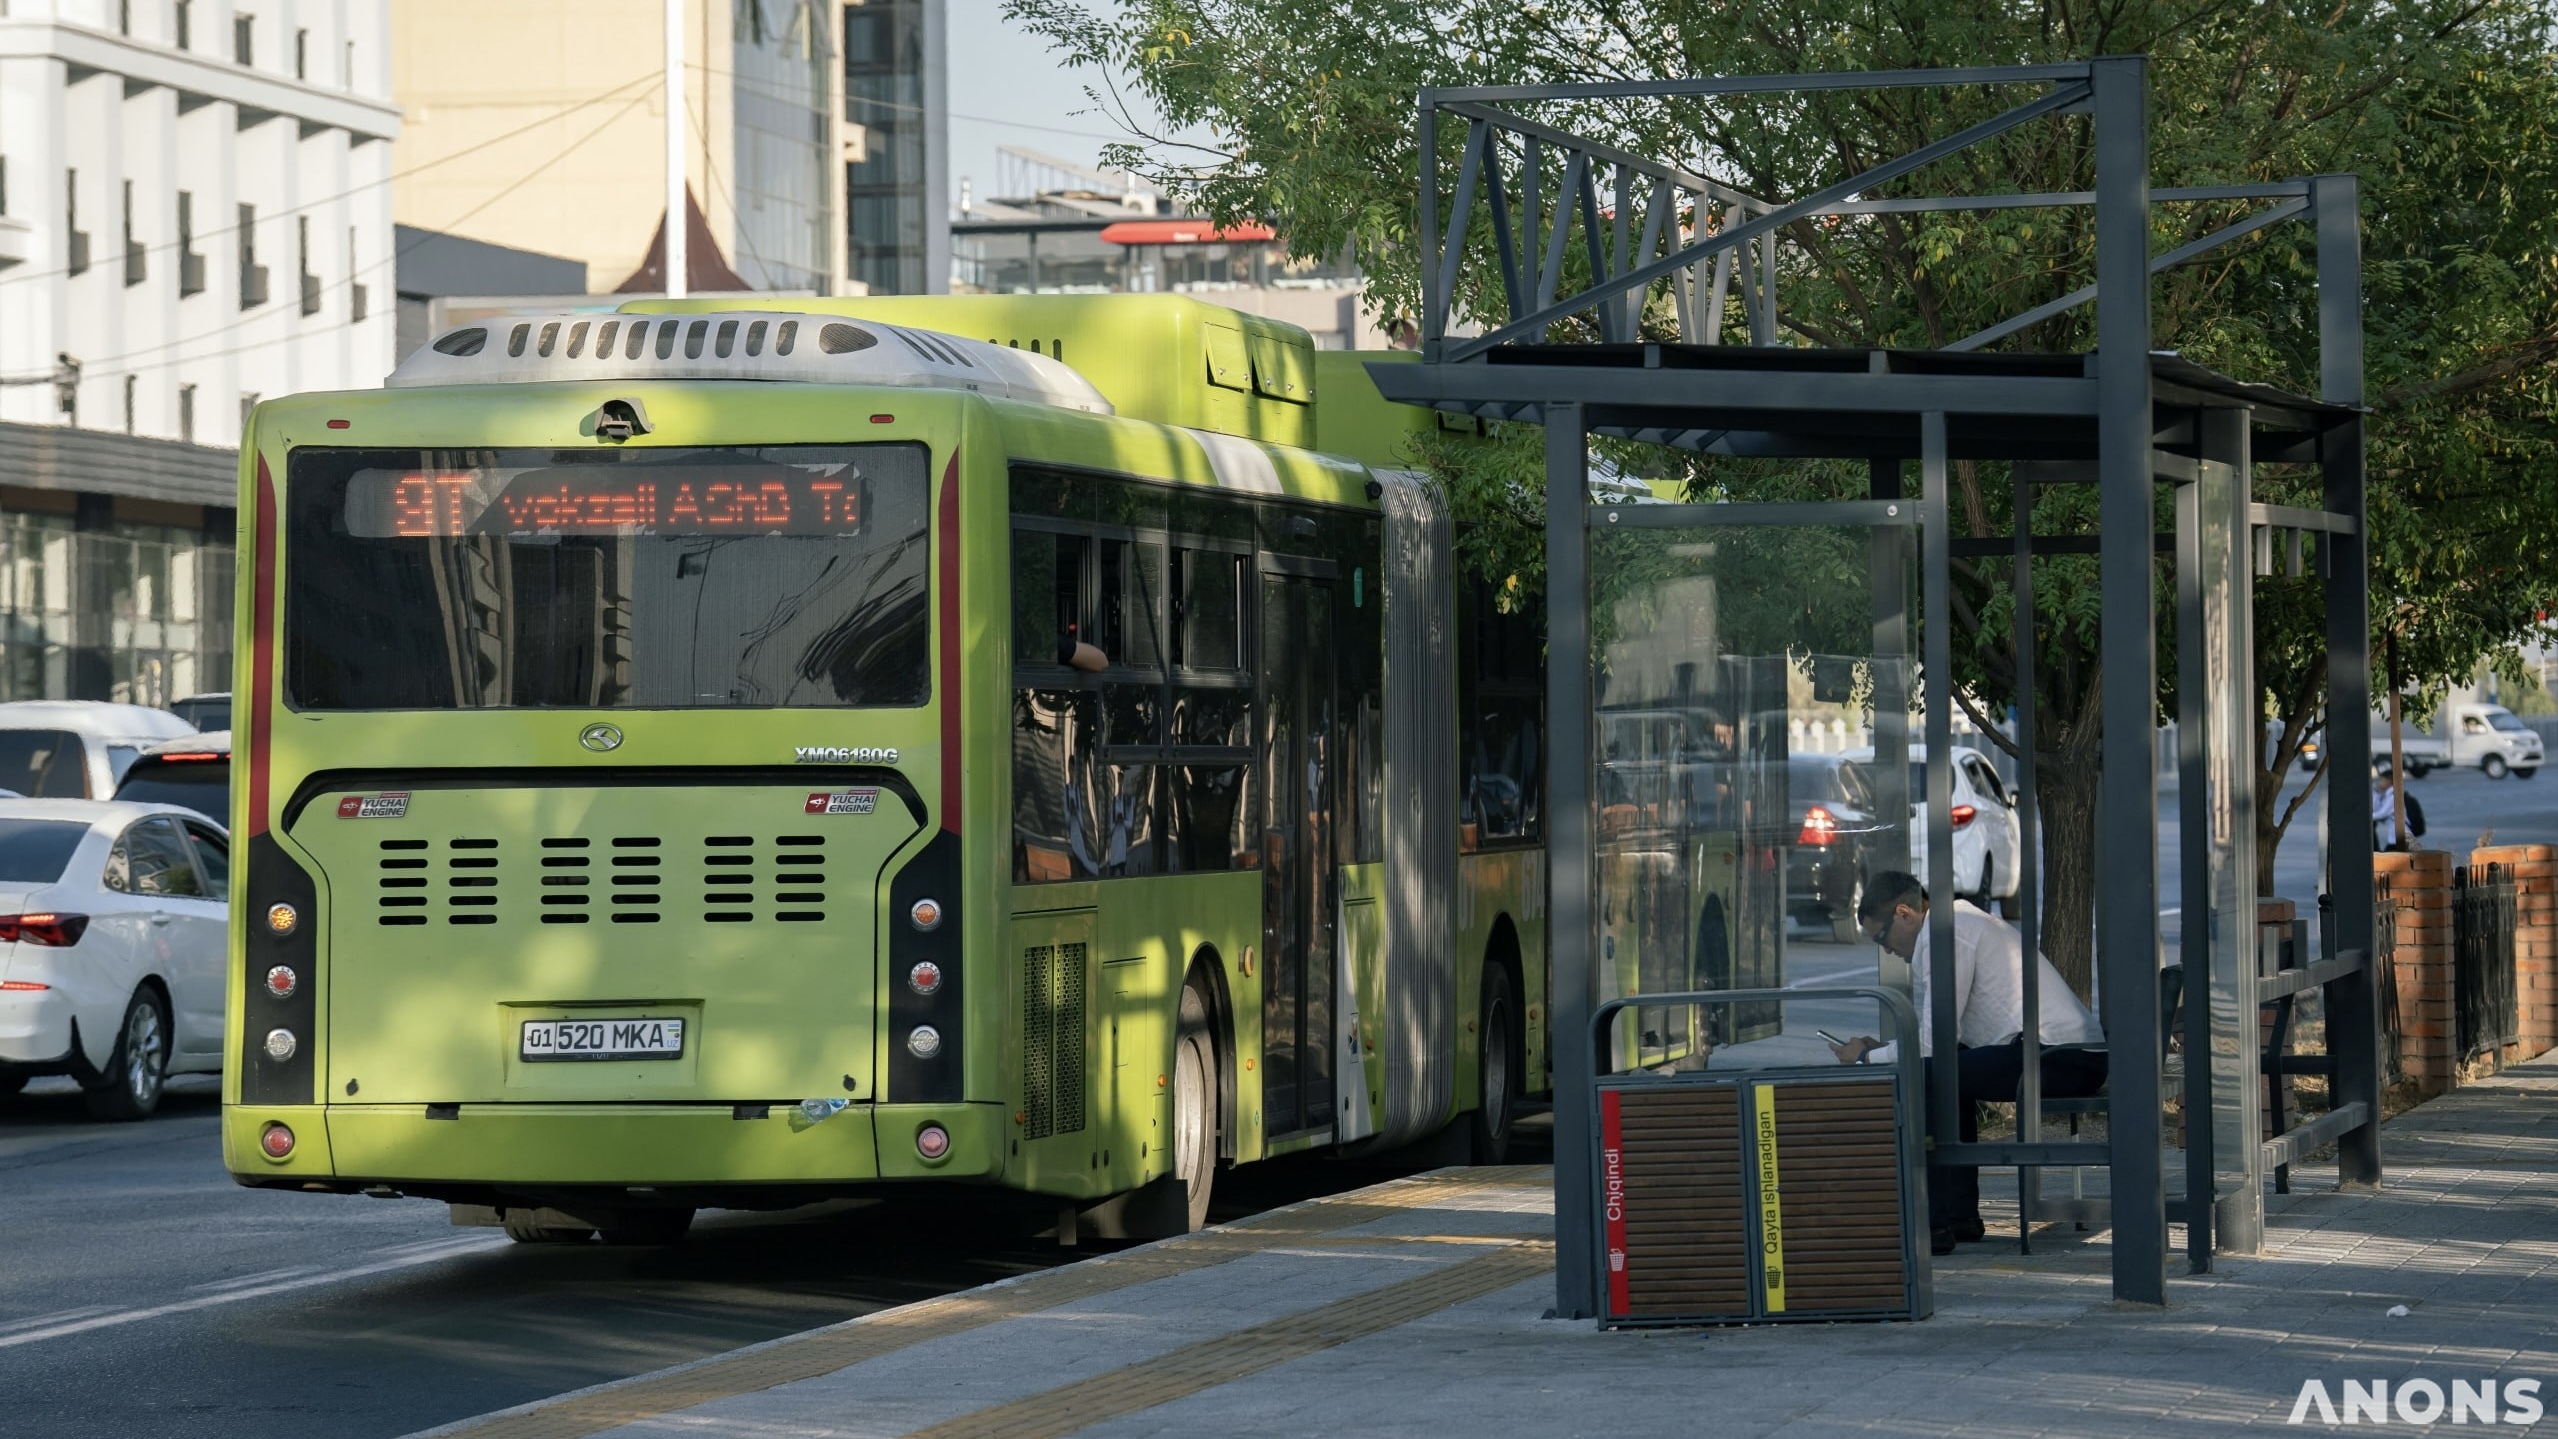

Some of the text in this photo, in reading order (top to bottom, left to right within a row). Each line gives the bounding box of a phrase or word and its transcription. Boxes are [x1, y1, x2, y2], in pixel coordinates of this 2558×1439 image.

[395, 477, 472, 536] 9T
[795, 747, 898, 763] XMQ6180G
[364, 798, 407, 808] YUCHAI
[832, 795, 876, 804] YUCHAI
[361, 807, 404, 817] ENGINE
[828, 804, 873, 813] ENGINE
[530, 1023, 679, 1050] 01 520 MKA UZ
[1604, 1148, 1624, 1221] Chiqindi
[1758, 1111, 1780, 1254] Qayta ishlanadigan
